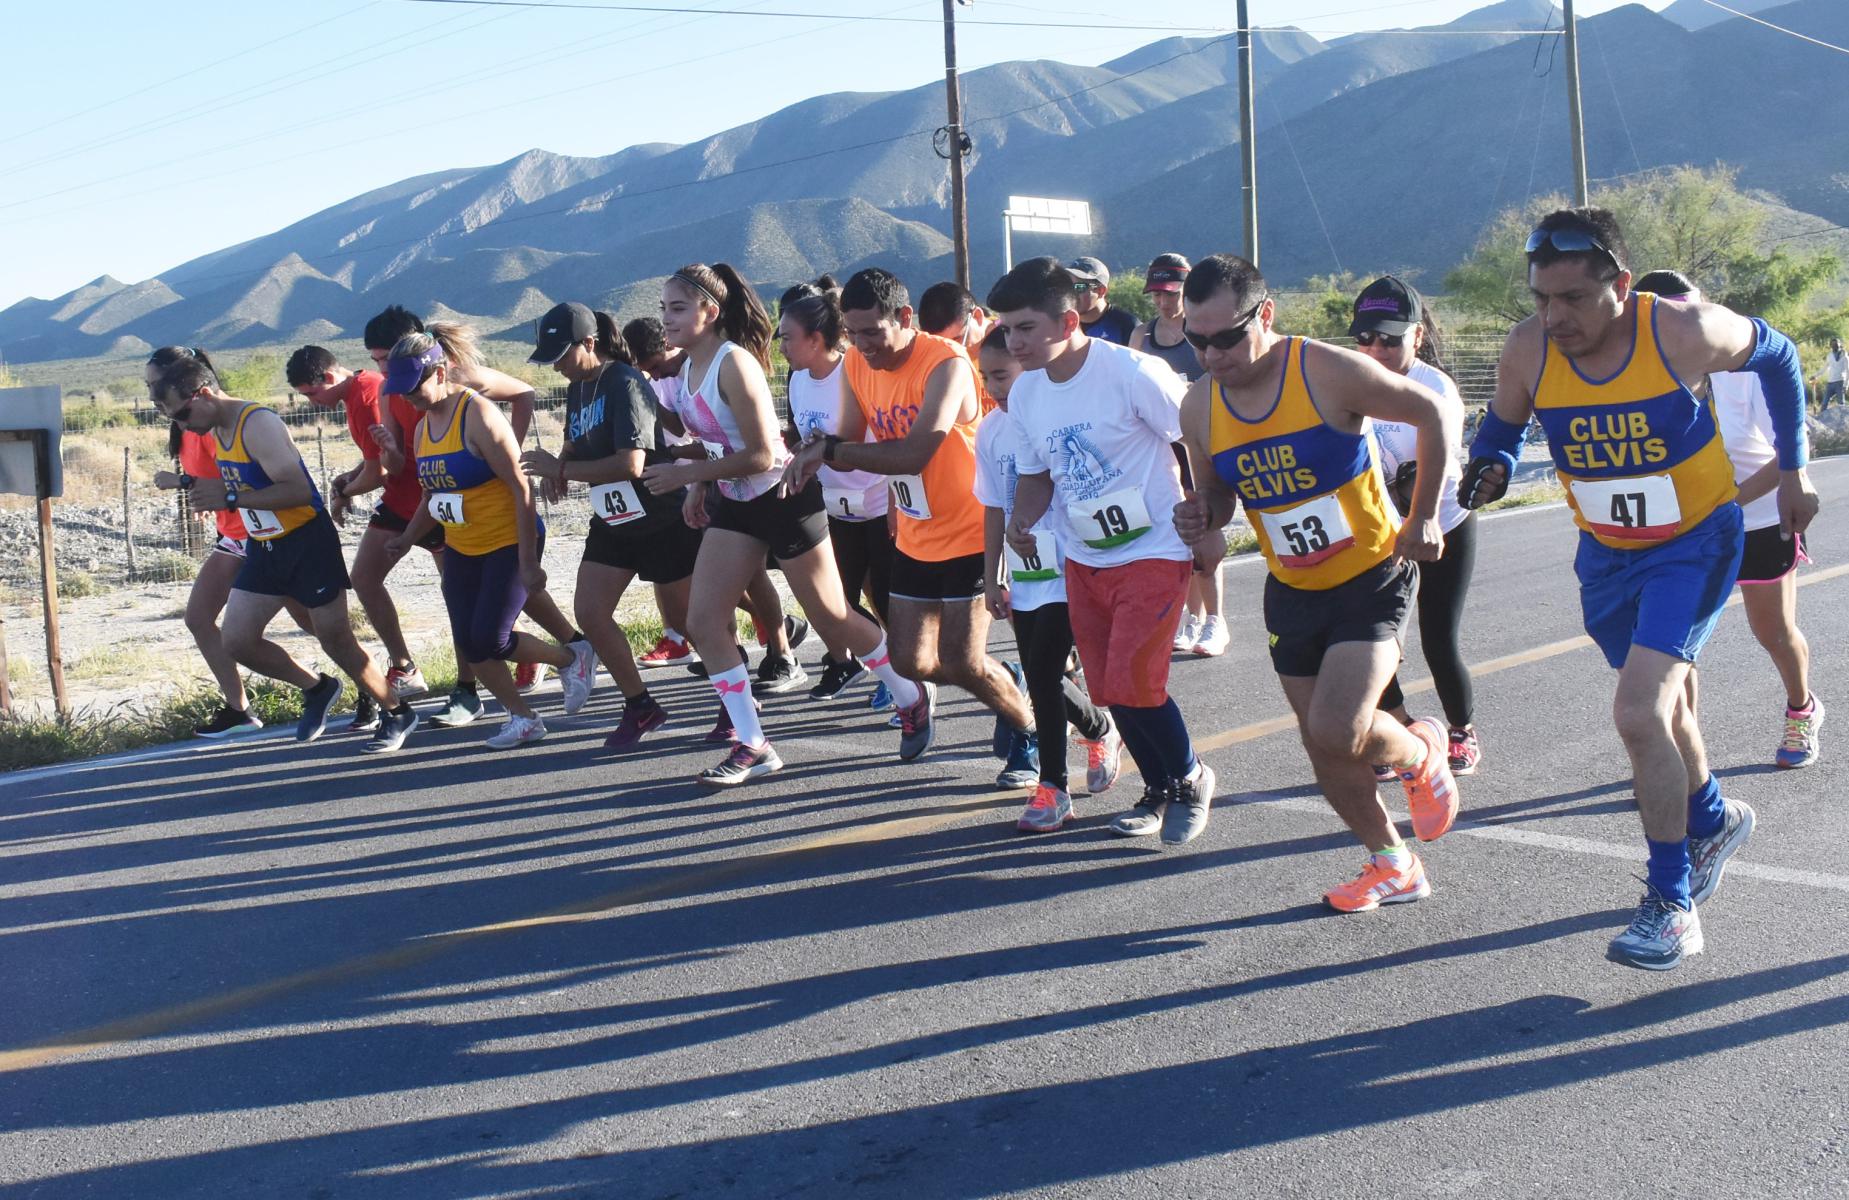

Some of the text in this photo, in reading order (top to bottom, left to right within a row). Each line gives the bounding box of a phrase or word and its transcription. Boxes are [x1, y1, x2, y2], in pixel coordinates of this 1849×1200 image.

[799, 409, 830, 426] 2 CARRERA
[1569, 411, 1650, 442] CLUB
[1046, 421, 1093, 454] 2 CARRERA
[1563, 437, 1668, 469] ELVIS
[419, 459, 446, 477] CLUB
[1236, 444, 1297, 477] CLUB
[893, 480, 912, 508] 10
[1236, 467, 1317, 499] ELVIS
[437, 501, 456, 524] 54
[604, 490, 628, 515] 43
[839, 497, 855, 517] 2
[1610, 491, 1647, 529] 47
[247, 509, 262, 529] 9
[1092, 504, 1130, 538] 19
[1281, 515, 1330, 557] 53
